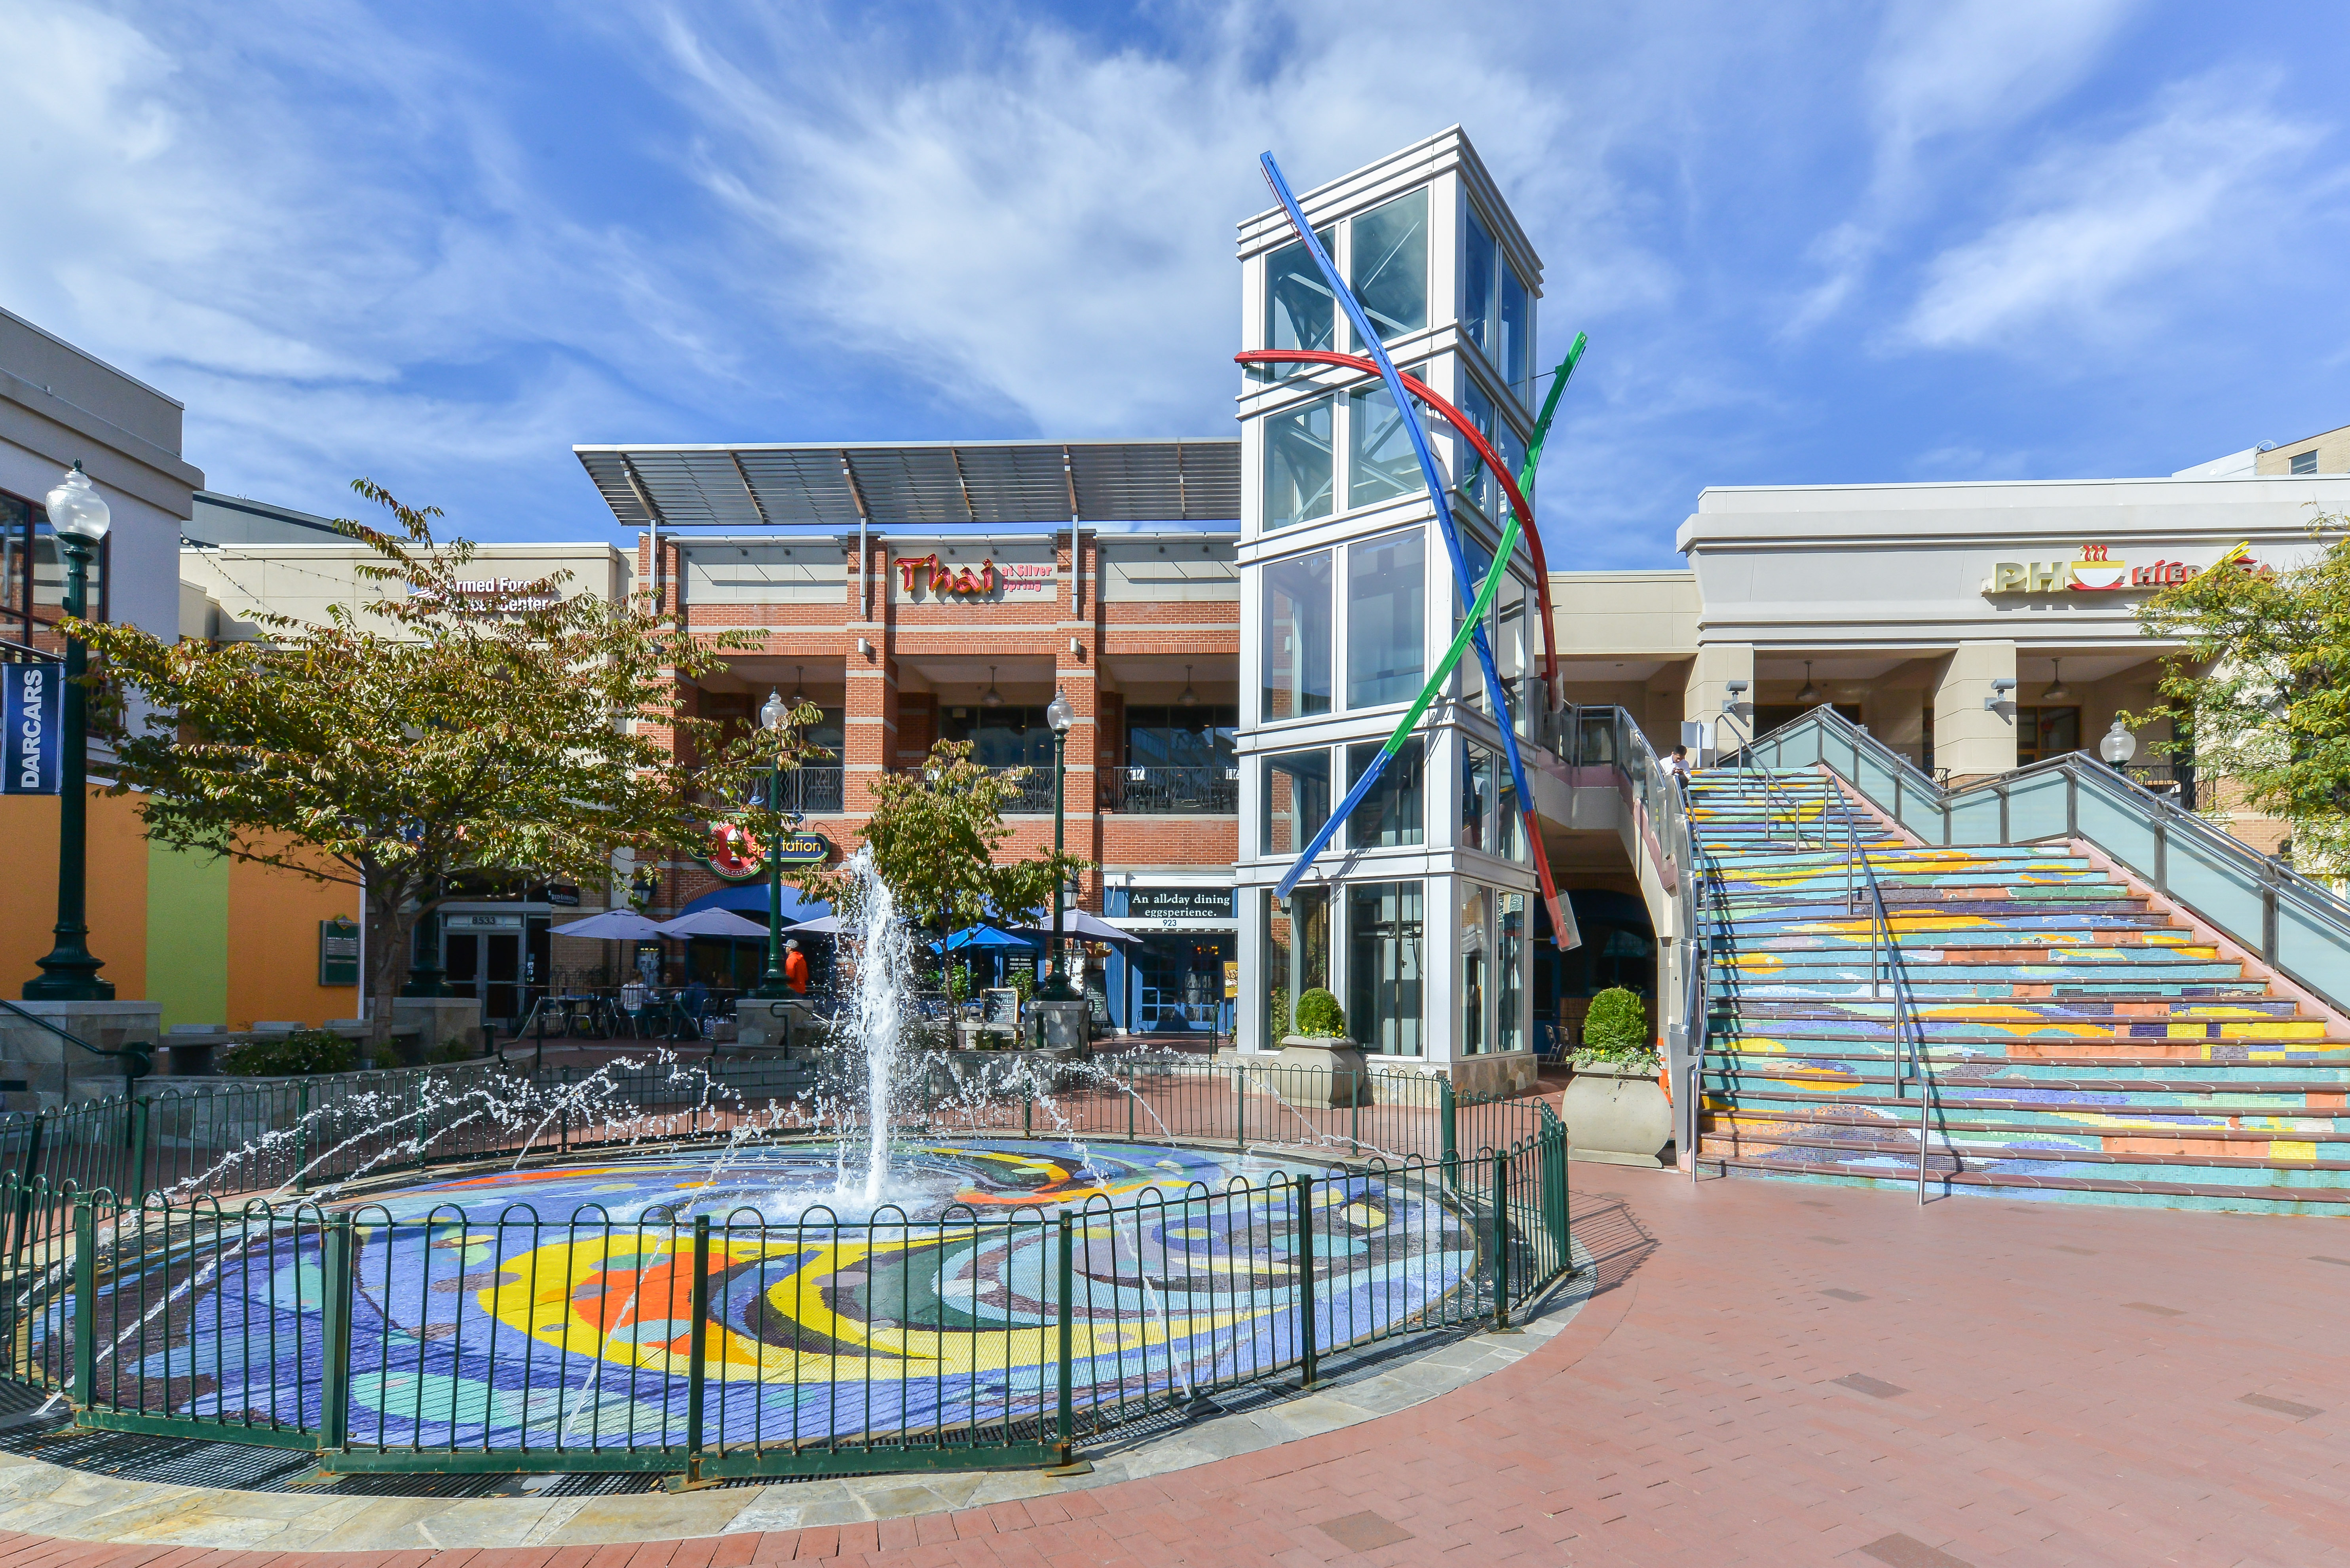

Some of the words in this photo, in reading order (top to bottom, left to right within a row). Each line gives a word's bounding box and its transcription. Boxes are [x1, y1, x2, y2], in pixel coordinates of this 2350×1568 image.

[893, 553, 994, 593] Thai
[1002, 566, 1014, 576] at
[1017, 564, 1052, 577] Silver
[1002, 578, 1041, 592] Spring
[21, 670, 42, 787] DARCARS
[561, 894, 578, 903] LOBSTER
[1132, 894, 1149, 904] An
[1194, 894, 1230, 906] dining
[1145, 907, 1217, 918] eggsperience.
[472, 916, 496, 924] 8533
